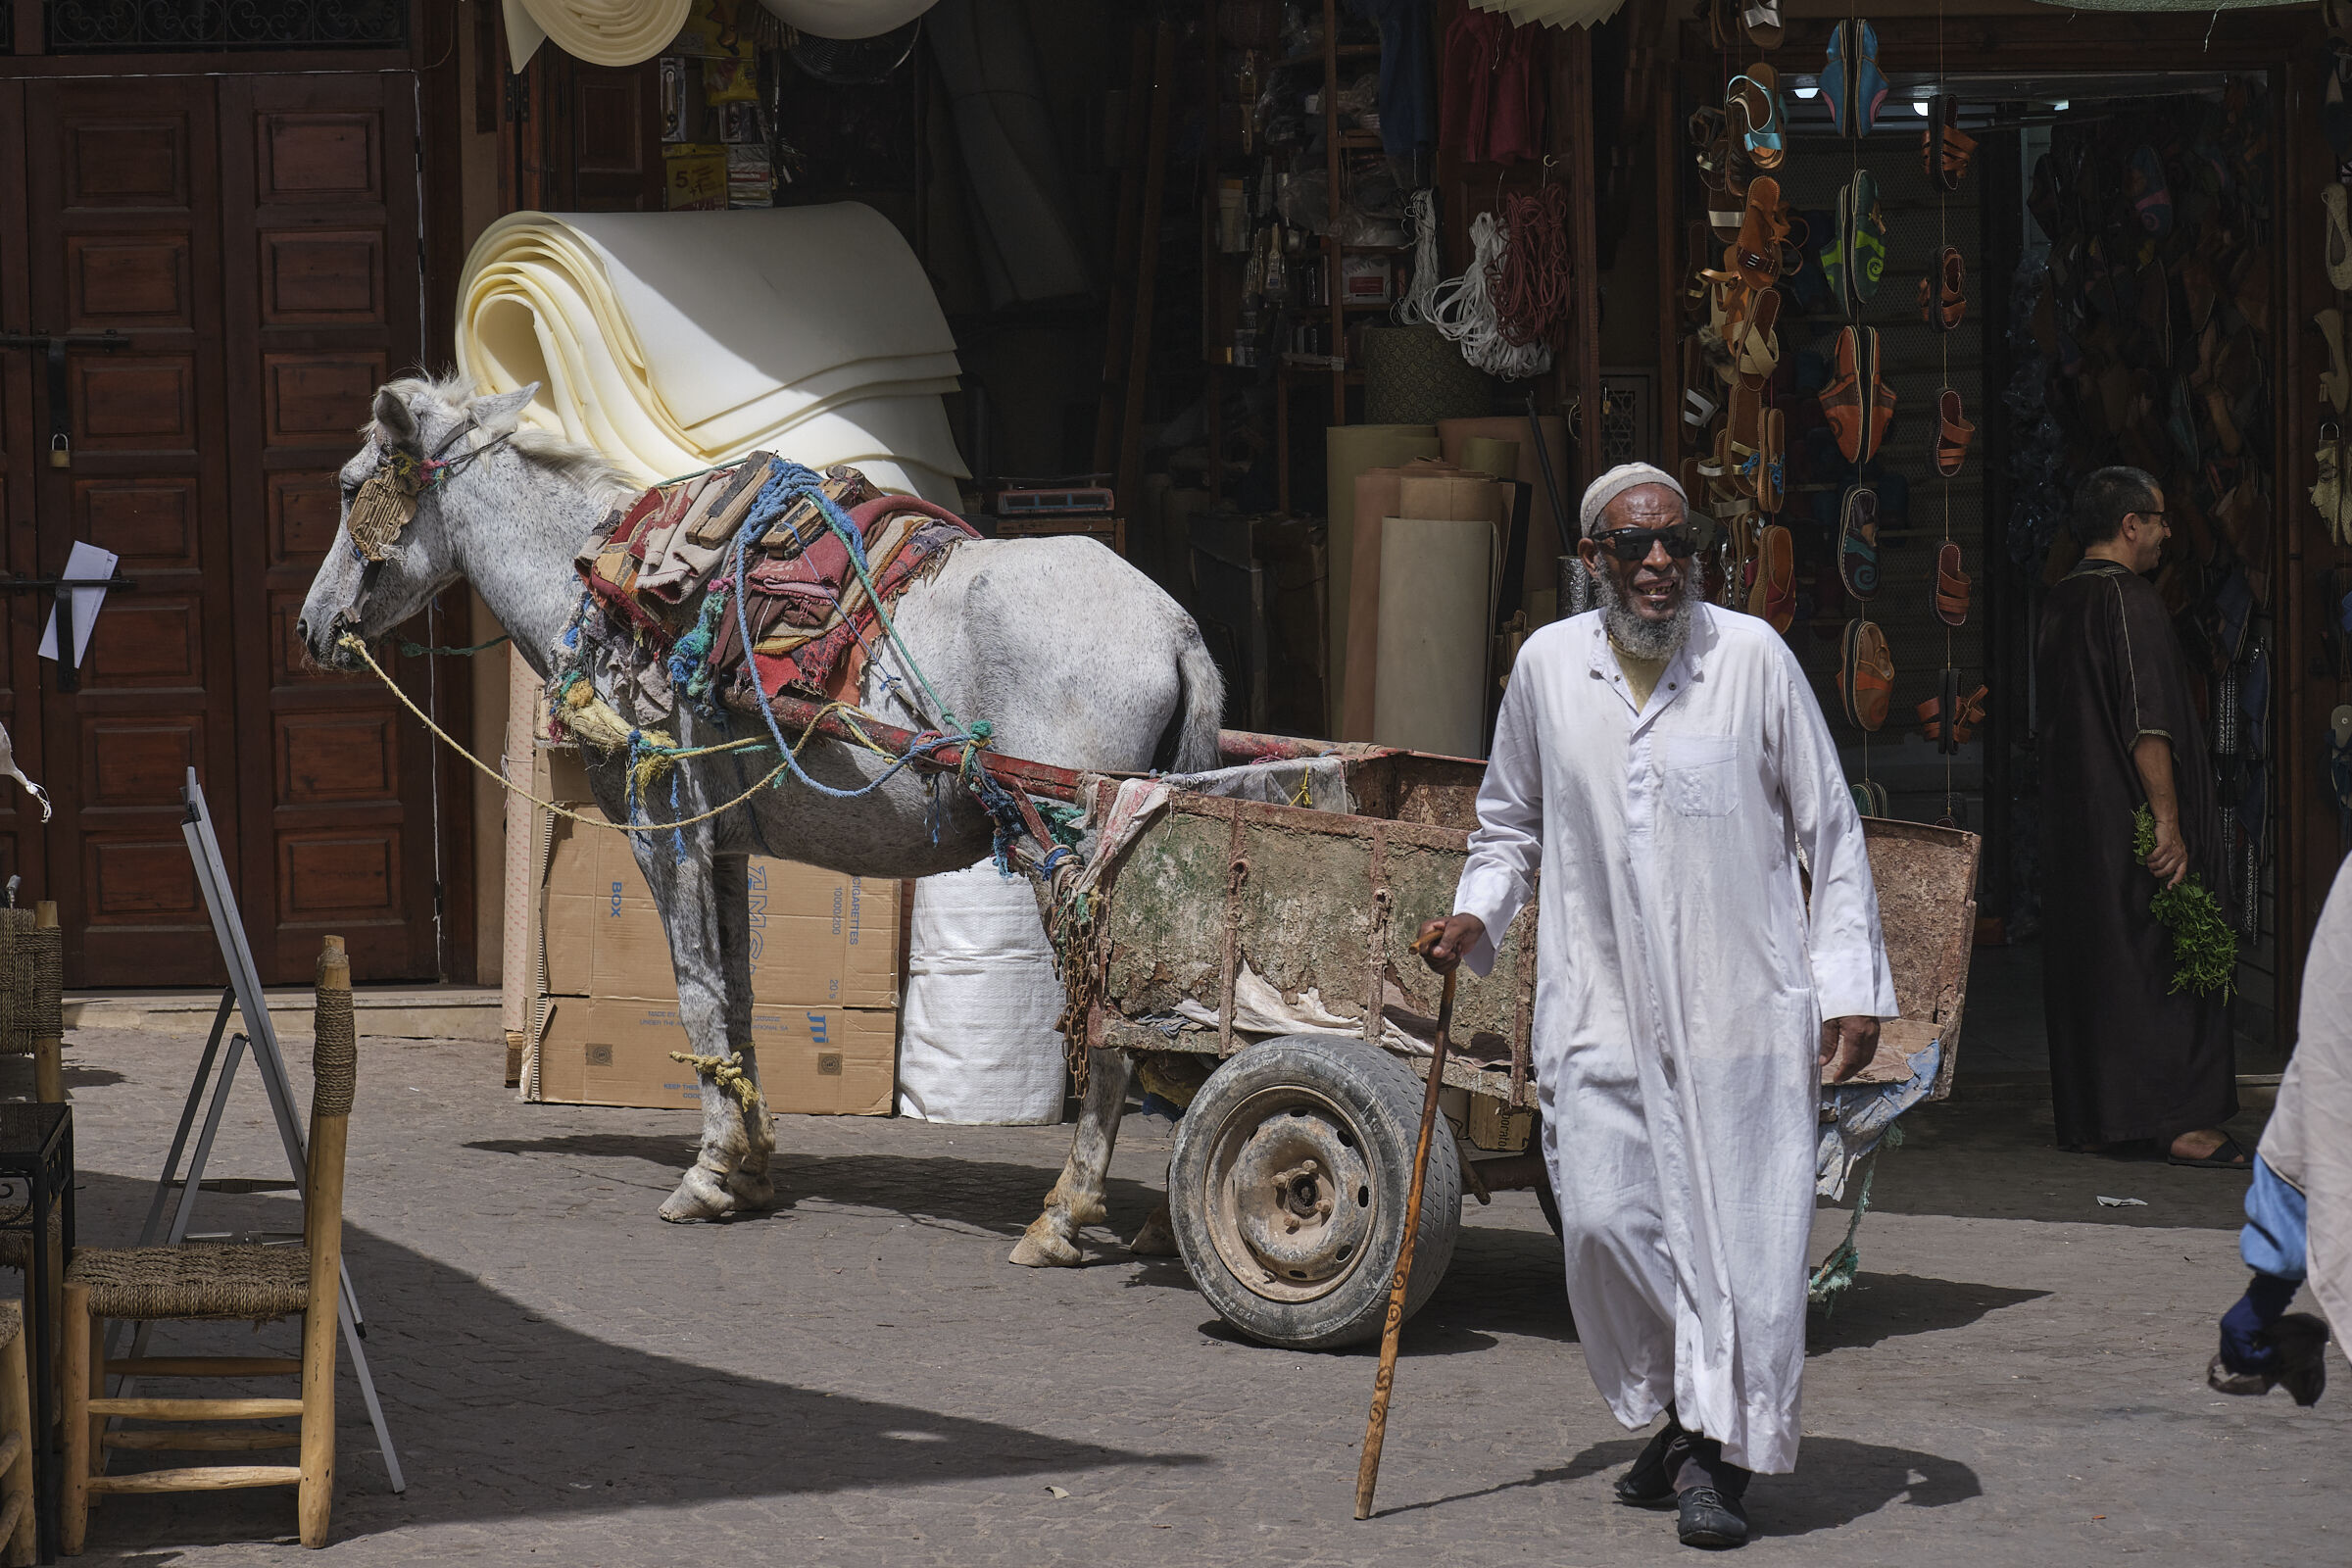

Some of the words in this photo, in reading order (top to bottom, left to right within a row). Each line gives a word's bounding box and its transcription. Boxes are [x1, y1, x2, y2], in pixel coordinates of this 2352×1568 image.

[675, 171, 689, 188] 5
[611, 882, 622, 917] BOX
[832, 886, 843, 935] 10000/200
[850, 877, 861, 946] CIGARETTES
